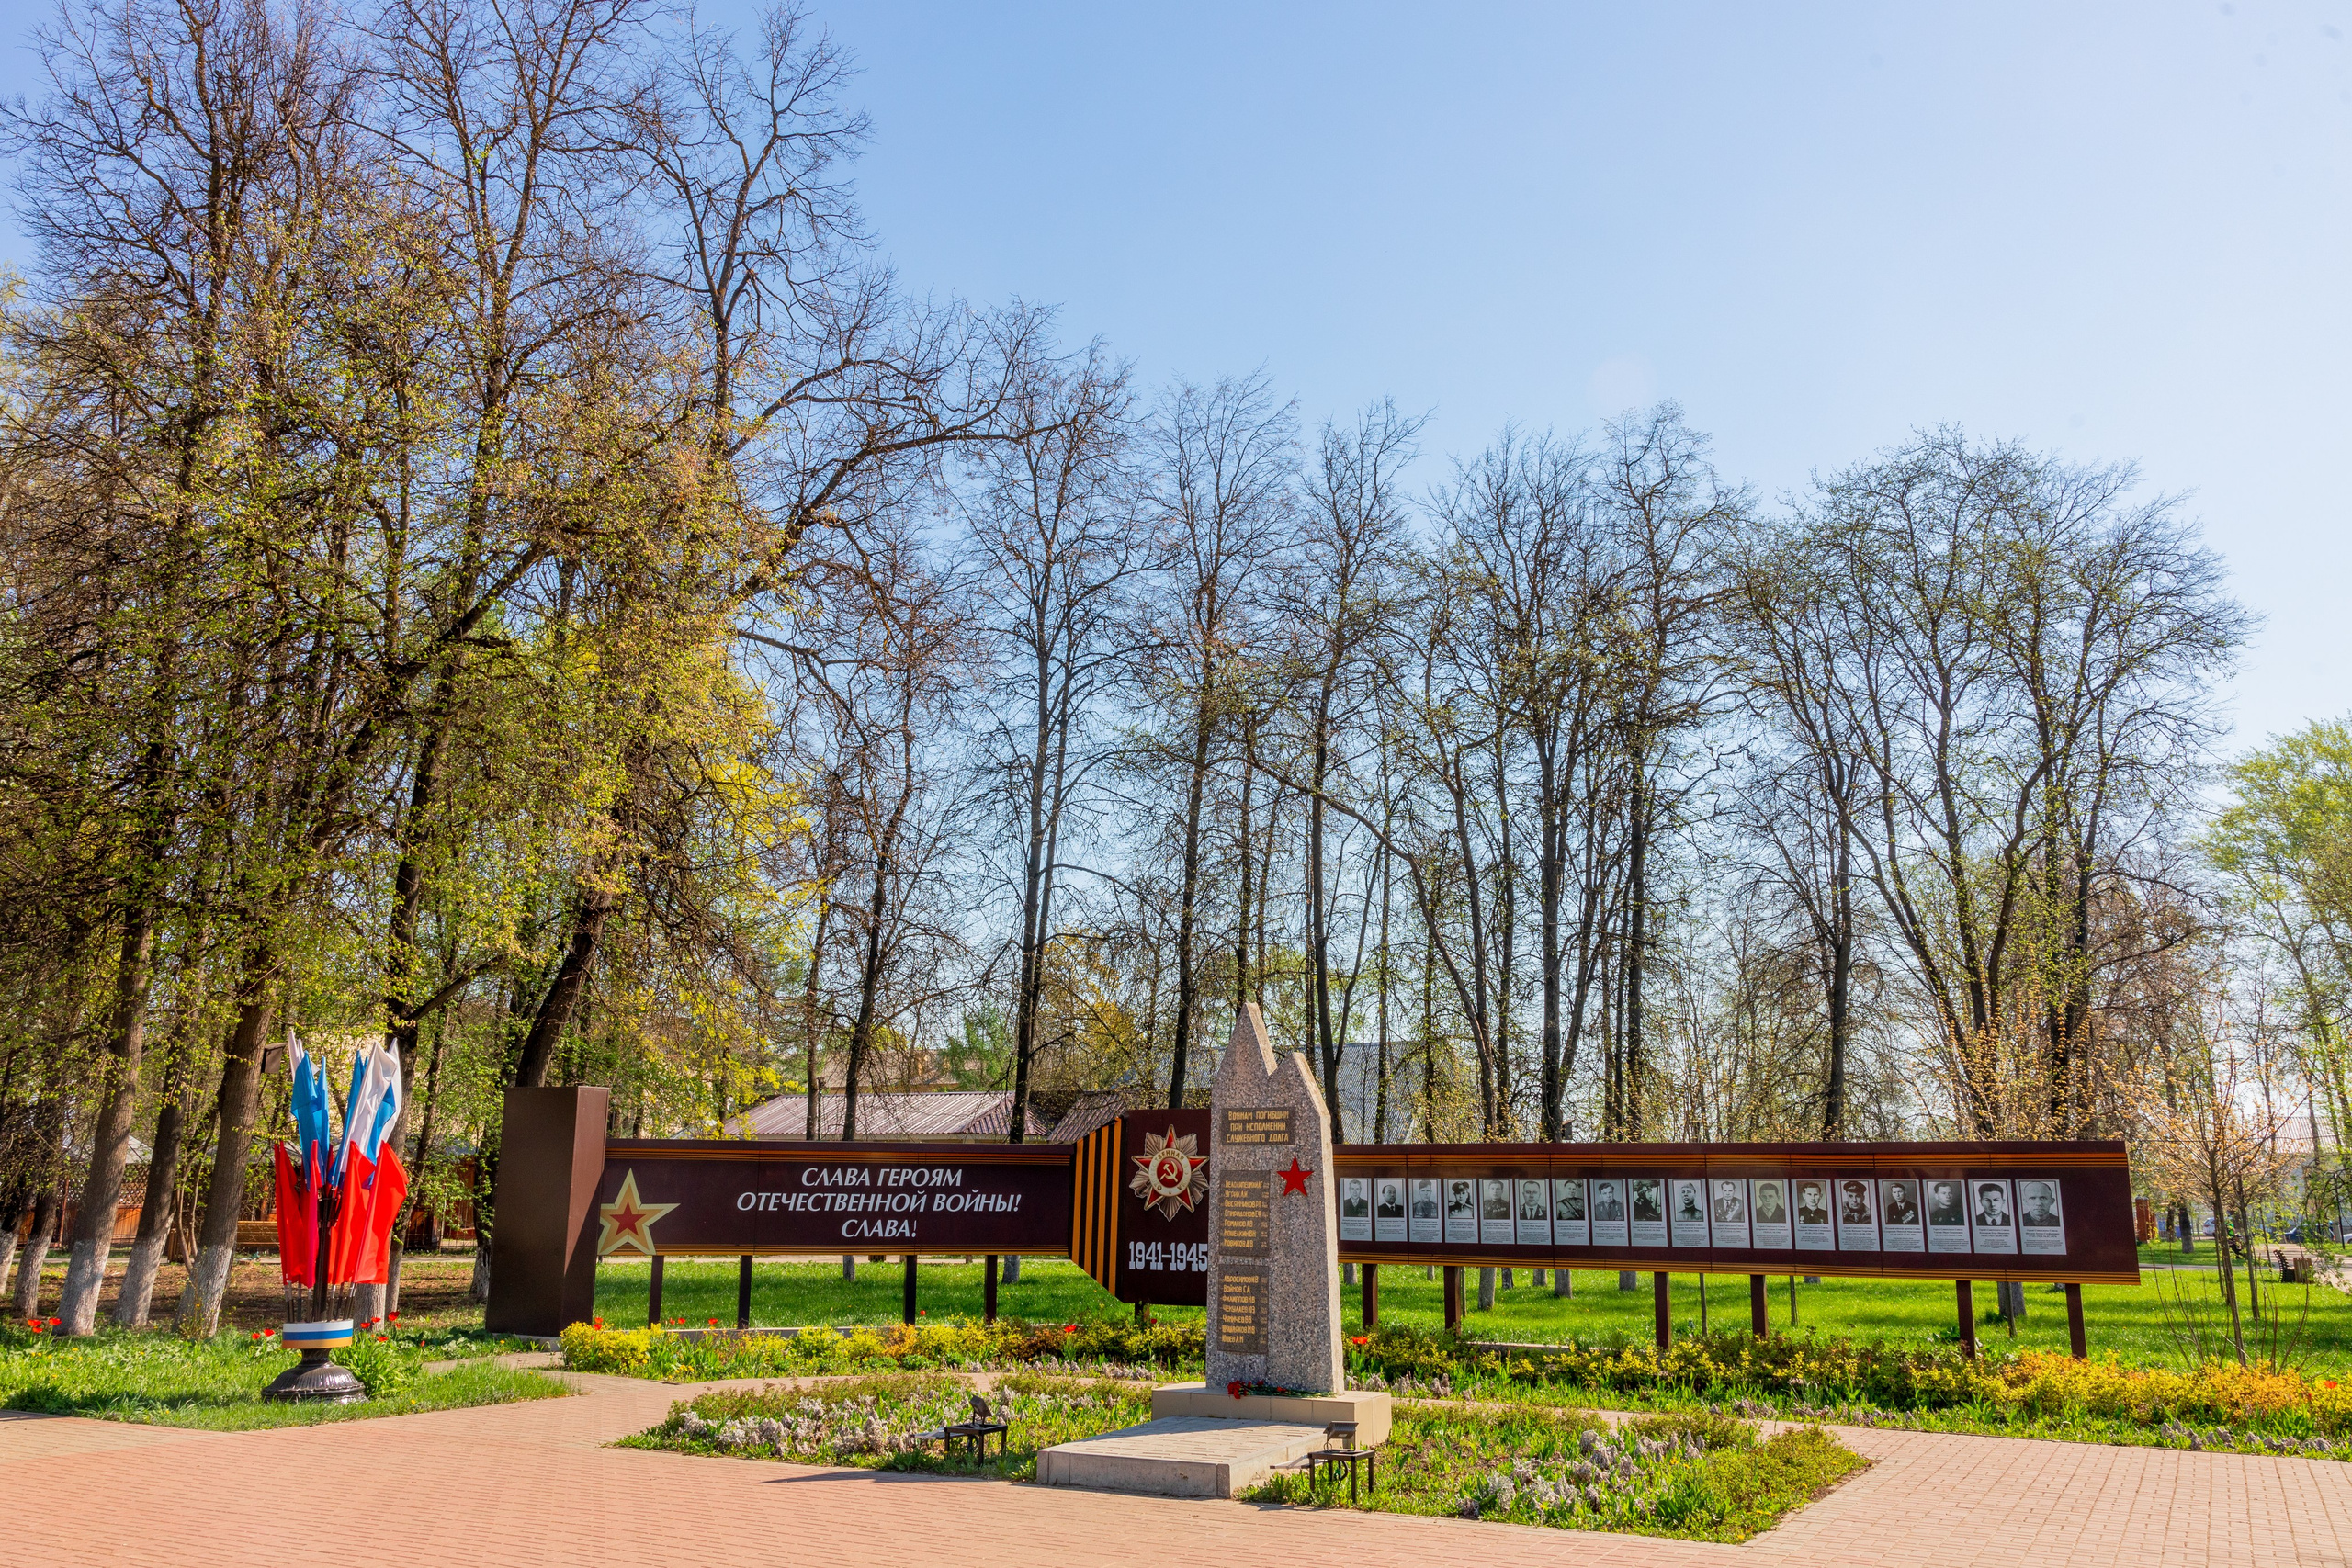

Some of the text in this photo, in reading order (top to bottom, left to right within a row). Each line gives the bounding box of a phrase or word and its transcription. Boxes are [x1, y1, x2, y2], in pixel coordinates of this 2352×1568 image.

[1228, 1111, 1253, 1120] ВОИНАМ
[1230, 1122, 1243, 1131] ПРИ
[1227, 1133, 1289, 1143] СЛУЖЕБНОГО ДОЛГА
[801, 1168, 963, 1187] СЛАВА ГЕРОЯМ
[736, 1189, 1022, 1213] ОТЕЧЕСТВЕННОЙ ВОЙНЫ!
[841, 1218, 917, 1238] СЛАВА!
[1128, 1241, 1208, 1272] 1941-1945
